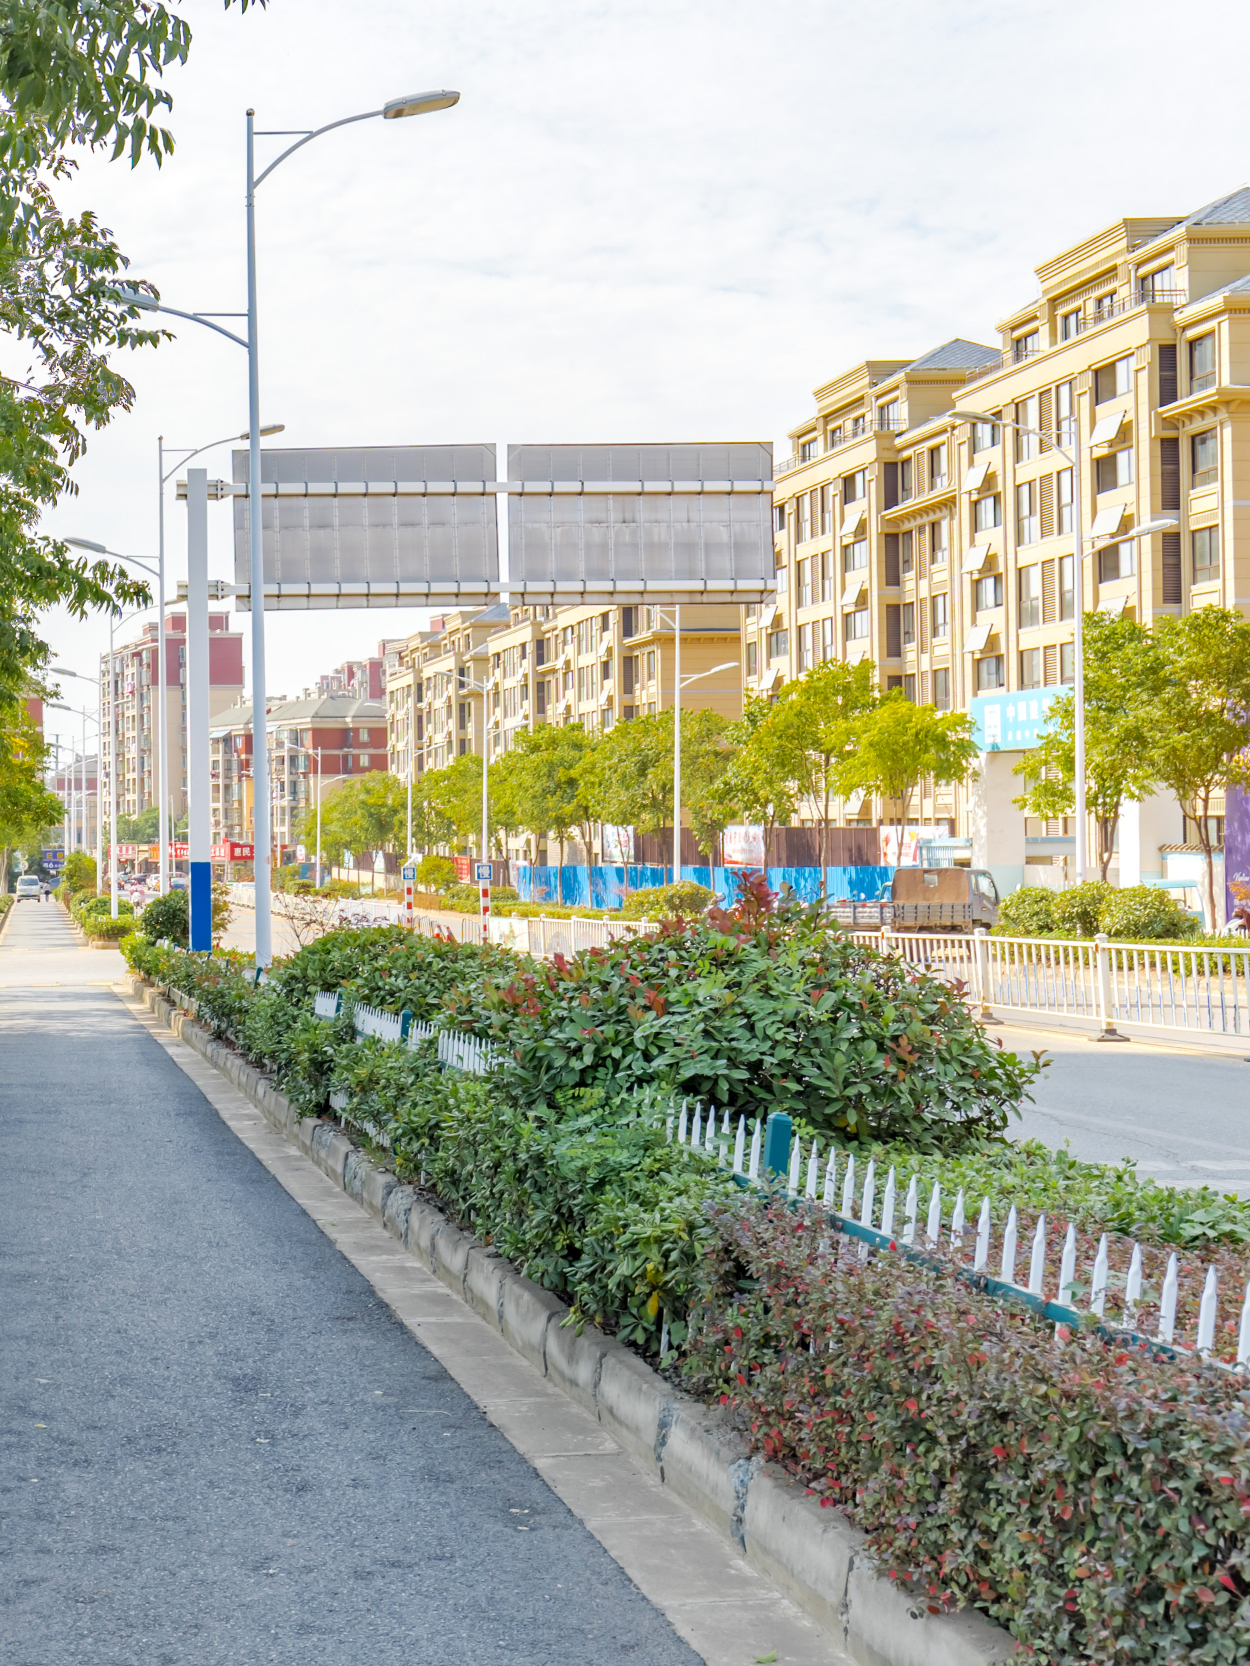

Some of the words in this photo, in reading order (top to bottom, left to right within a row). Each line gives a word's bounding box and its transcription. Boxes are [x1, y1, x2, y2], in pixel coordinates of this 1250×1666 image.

[233, 847, 254, 857] 惠民
[403, 868, 414, 879] 慢
[478, 865, 490, 878] 慢
